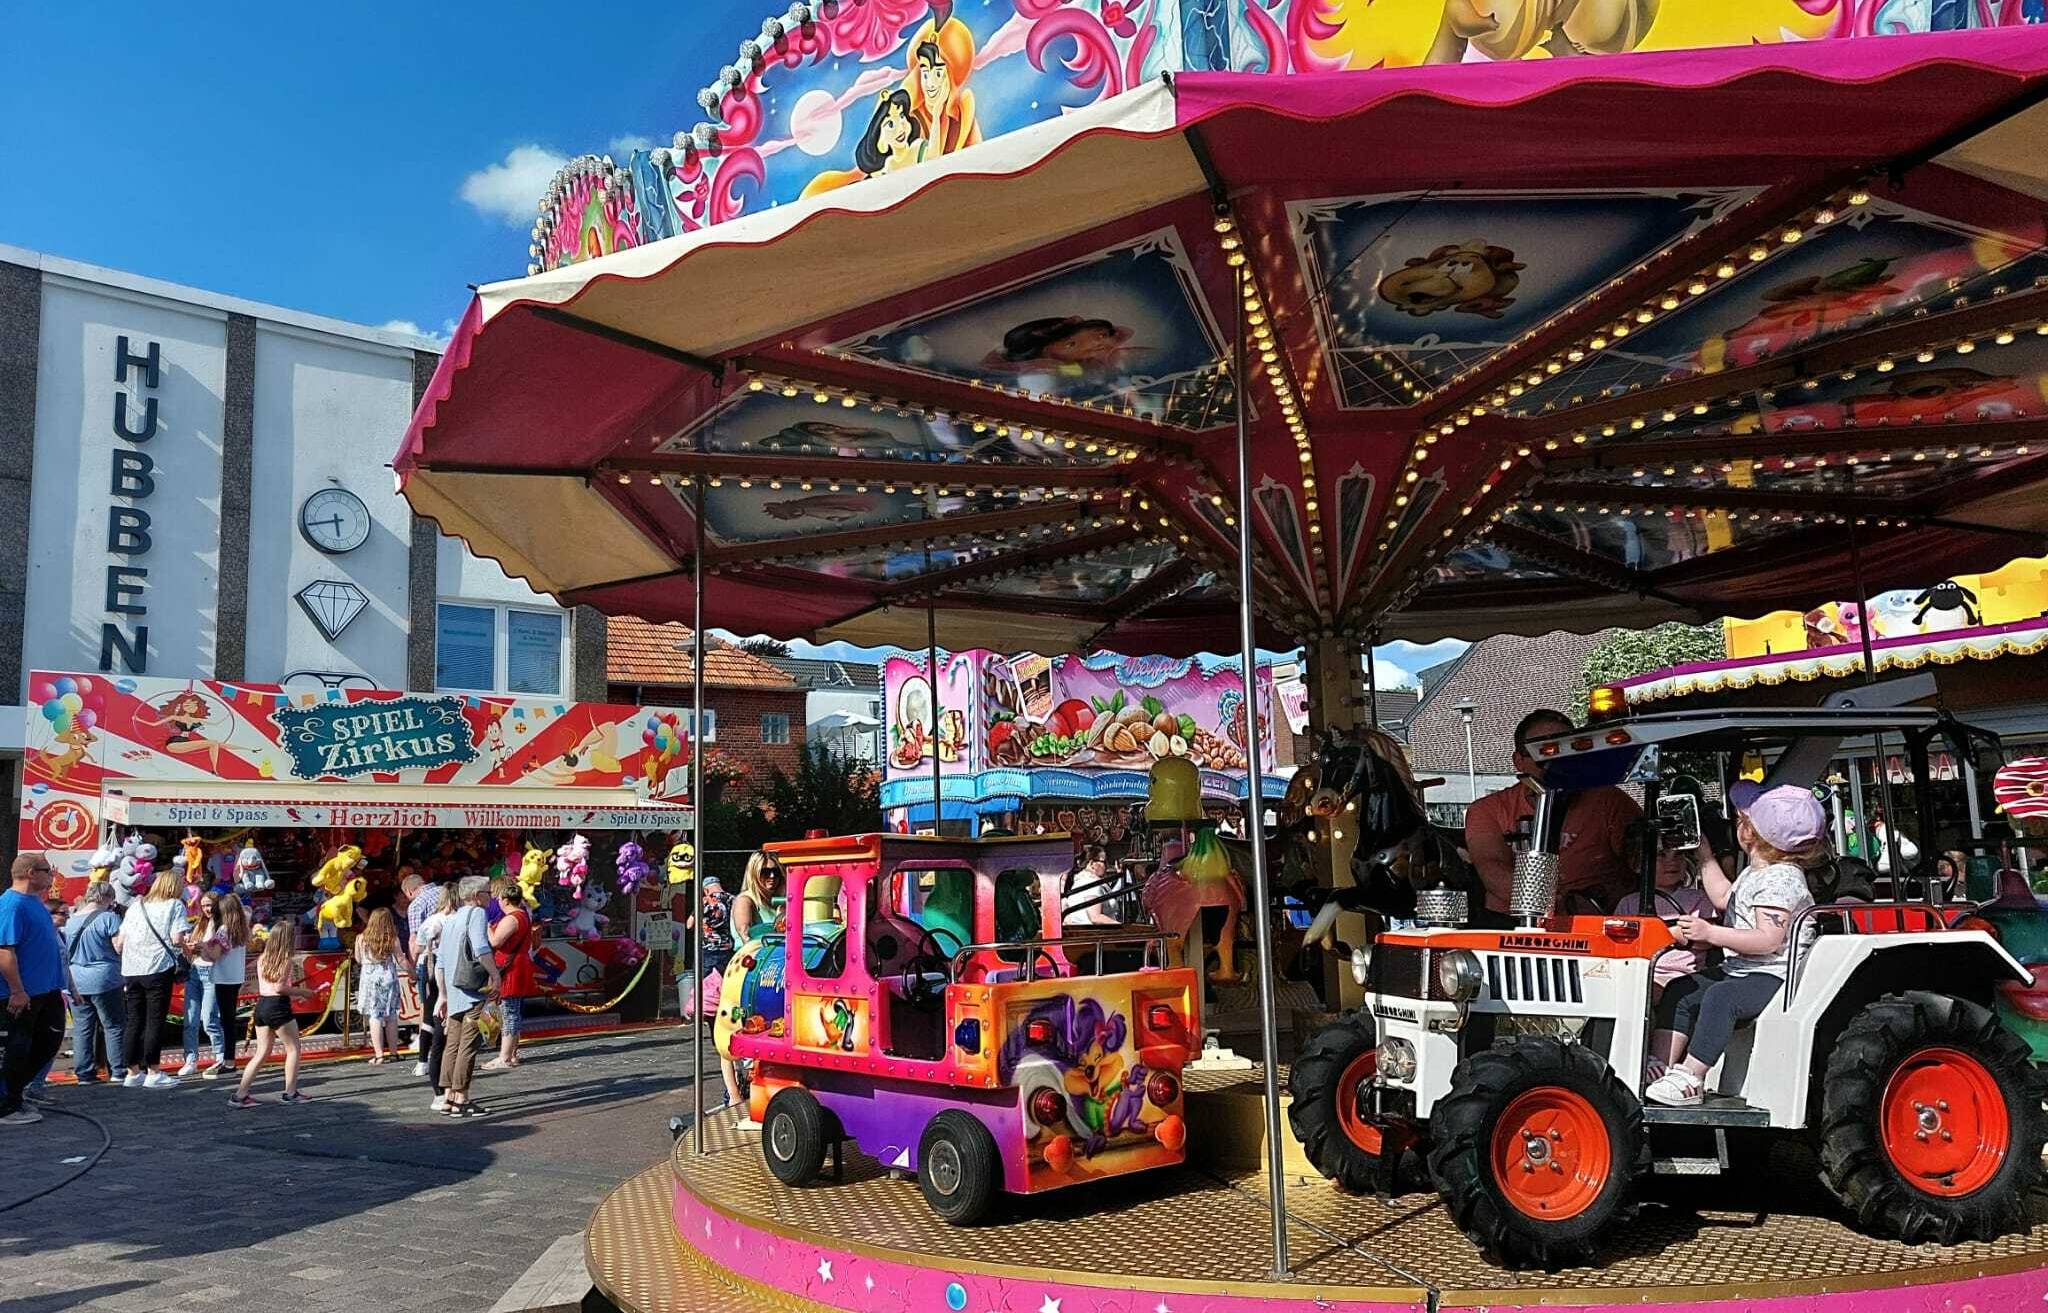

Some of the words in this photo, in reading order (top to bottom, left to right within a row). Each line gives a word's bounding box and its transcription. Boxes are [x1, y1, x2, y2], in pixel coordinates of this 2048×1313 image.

[100, 336, 160, 673] HUBBEN
[331, 707, 423, 742] SPIEL
[317, 733, 456, 771] Zirkus
[168, 807, 207, 823] Spiel
[211, 808, 222, 821] &
[226, 808, 268, 824] Spass
[328, 810, 437, 827] Herzlich
[464, 810, 561, 828] Willkommen
[609, 811, 637, 826] Spiel
[641, 813, 650, 825] &
[651, 812, 681, 828] Spass
[1499, 935, 1591, 953] LAMBORGHINI
[1373, 1003, 1418, 1024] LAMBORGHINI
